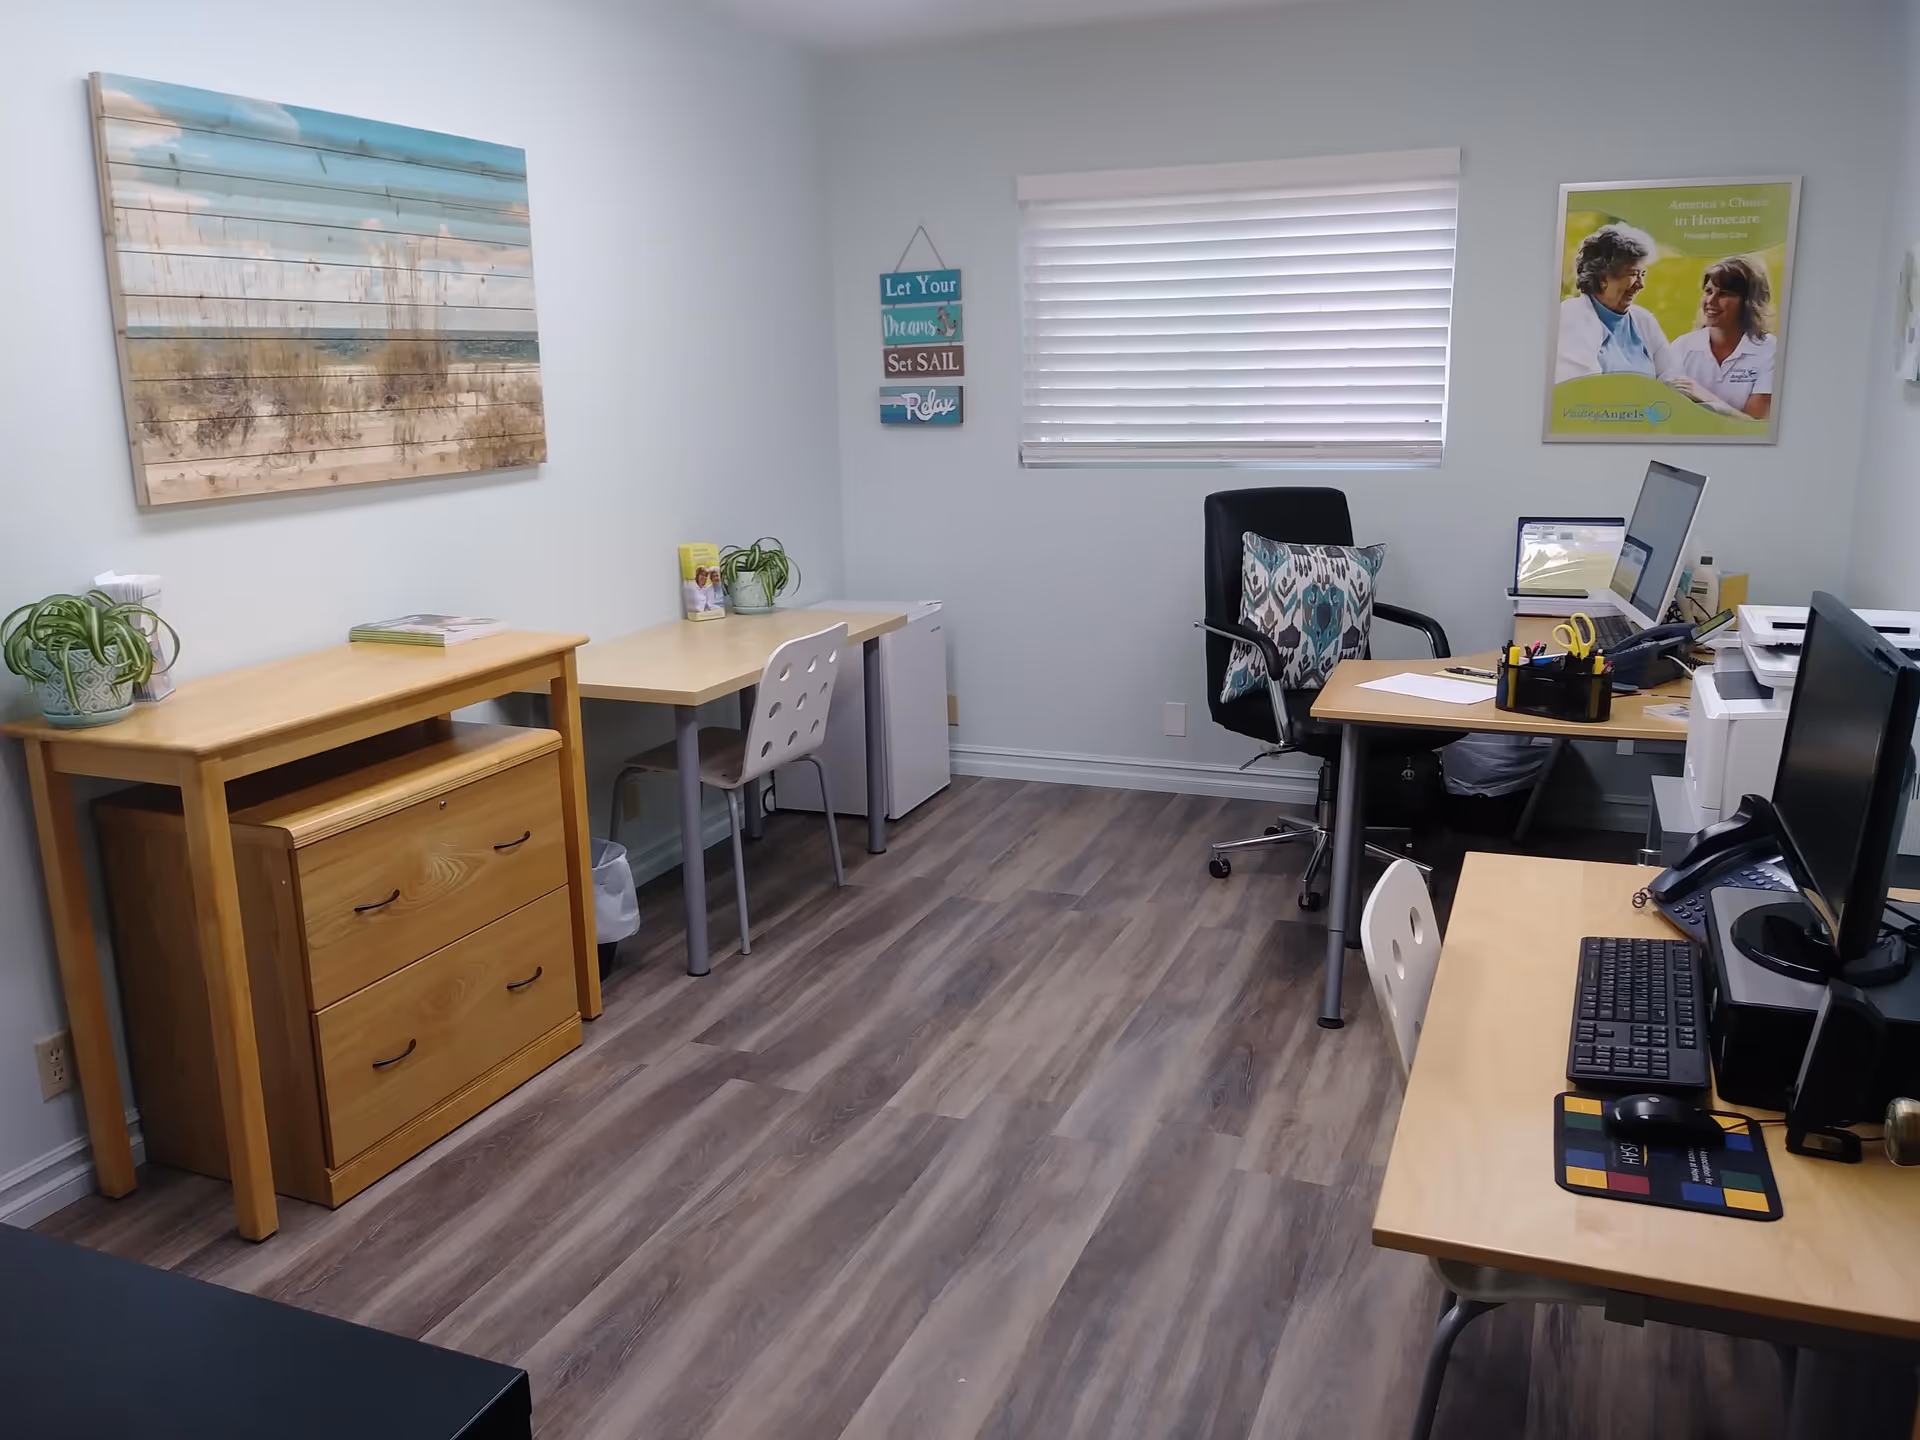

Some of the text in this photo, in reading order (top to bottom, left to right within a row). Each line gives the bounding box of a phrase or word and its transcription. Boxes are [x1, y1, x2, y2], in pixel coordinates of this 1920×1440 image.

[1691, 214, 1761, 226] Homecare
[885, 275, 956, 297] Let Your
[883, 314, 937, 338] Dreams
[888, 352, 960, 373] Set SAIL
[901, 389, 956, 420] Relax
